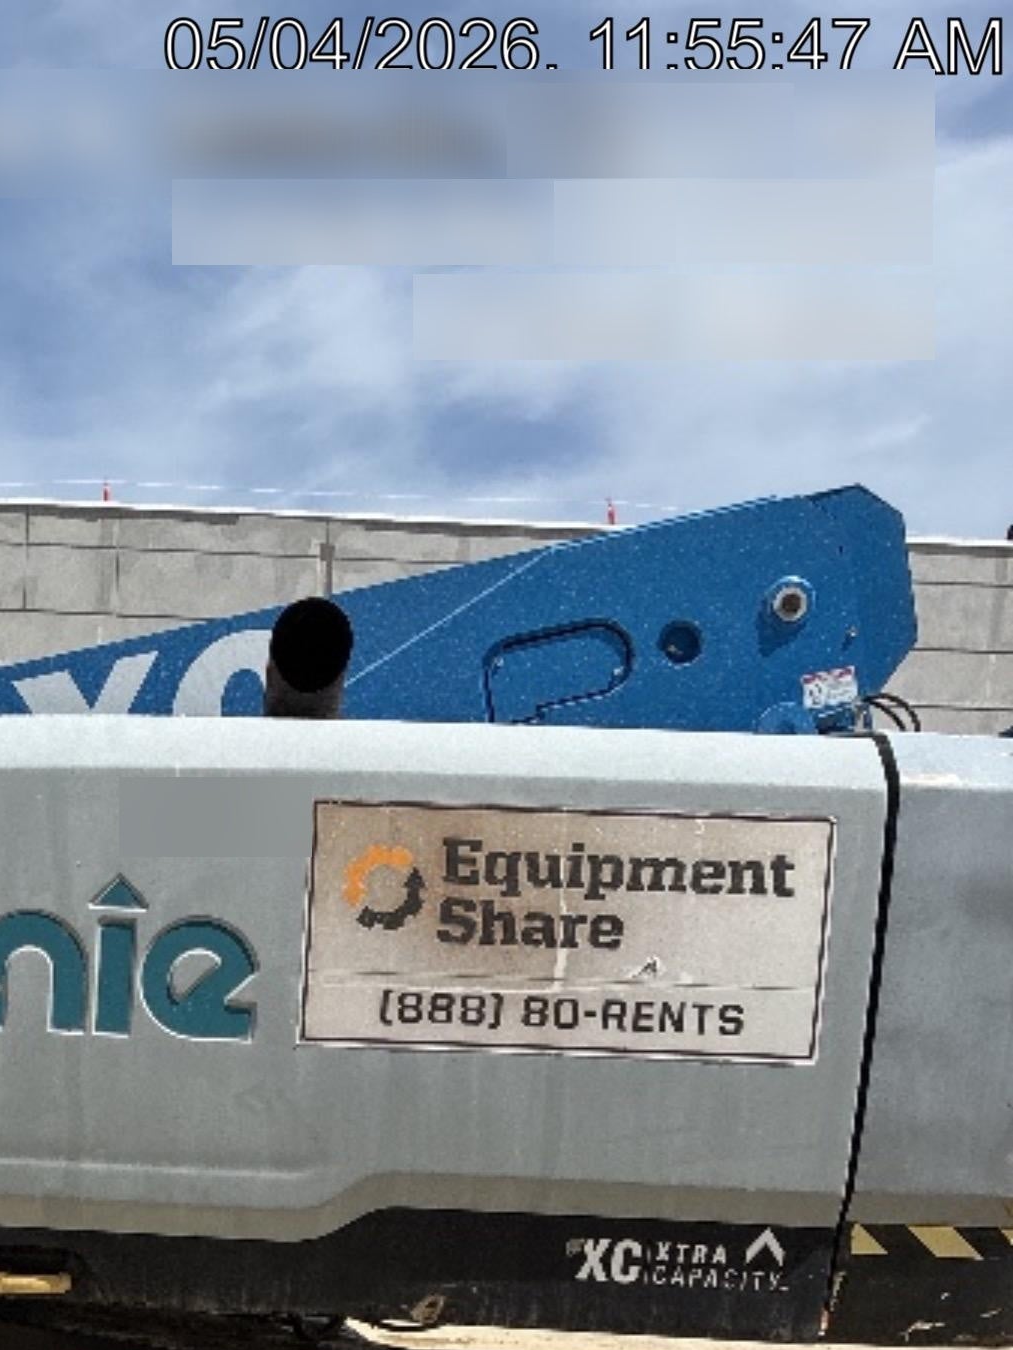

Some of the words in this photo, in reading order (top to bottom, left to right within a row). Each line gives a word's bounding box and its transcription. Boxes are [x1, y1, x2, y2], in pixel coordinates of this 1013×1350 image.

[441, 837, 796, 900] Equipment
[435, 896, 625, 950] Share
[377, 988, 504, 1029] (888)
[521, 995, 745, 1036] 80-RENTS
[574, 1237, 643, 1284] XC
[654, 1241, 727, 1264] XTRA
[652, 1265, 782, 1292] CAPACITY
